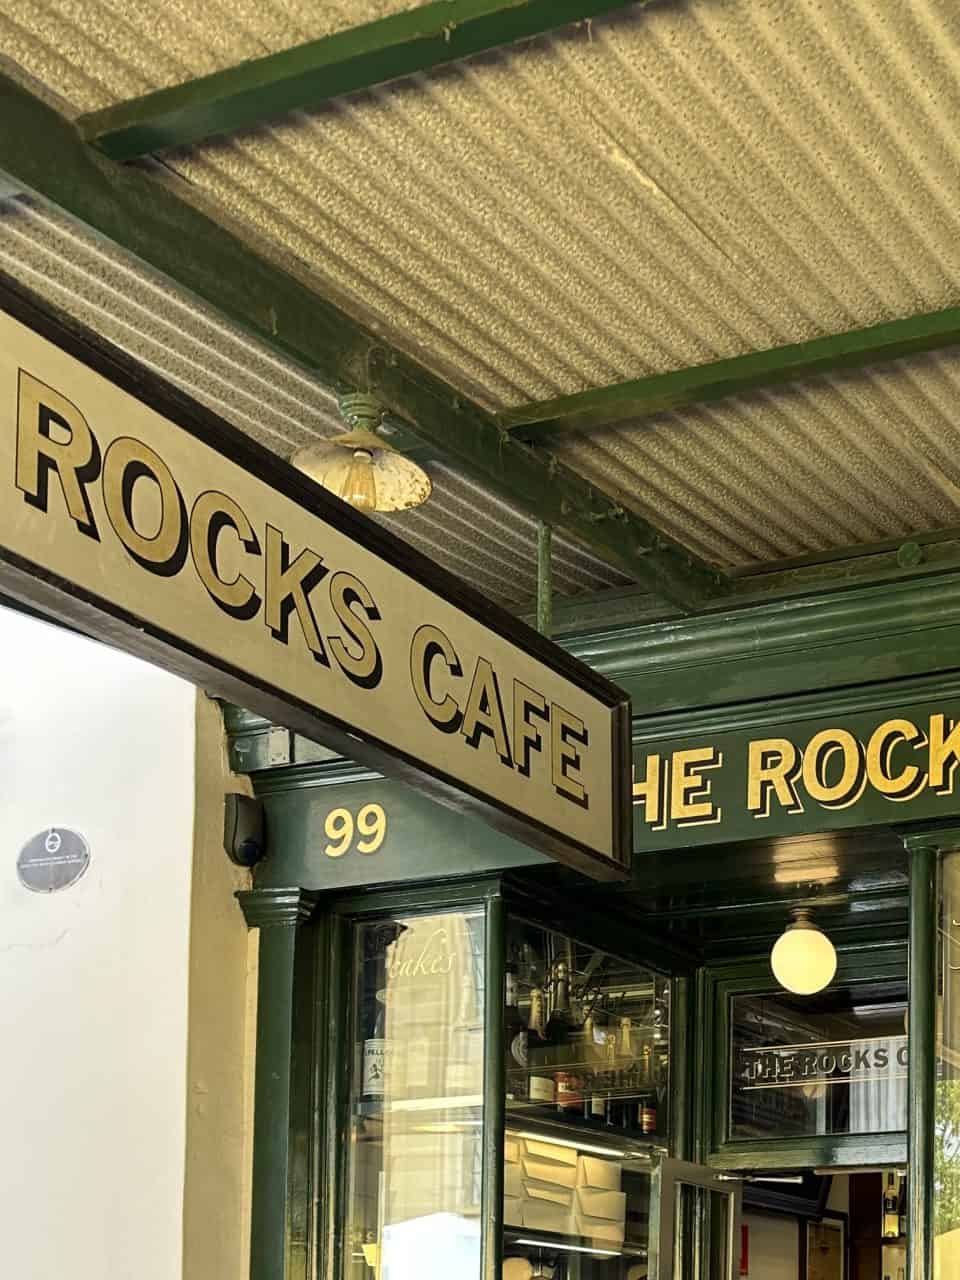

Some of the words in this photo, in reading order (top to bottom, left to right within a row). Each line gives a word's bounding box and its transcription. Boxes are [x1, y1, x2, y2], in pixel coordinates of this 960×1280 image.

[15, 367, 383, 690] ROCKS
[410, 624, 589, 809] CAFE
[632, 746, 722, 831] HE
[323, 803, 387, 858] 99
[800, 1048, 889, 1078] ROCKS
